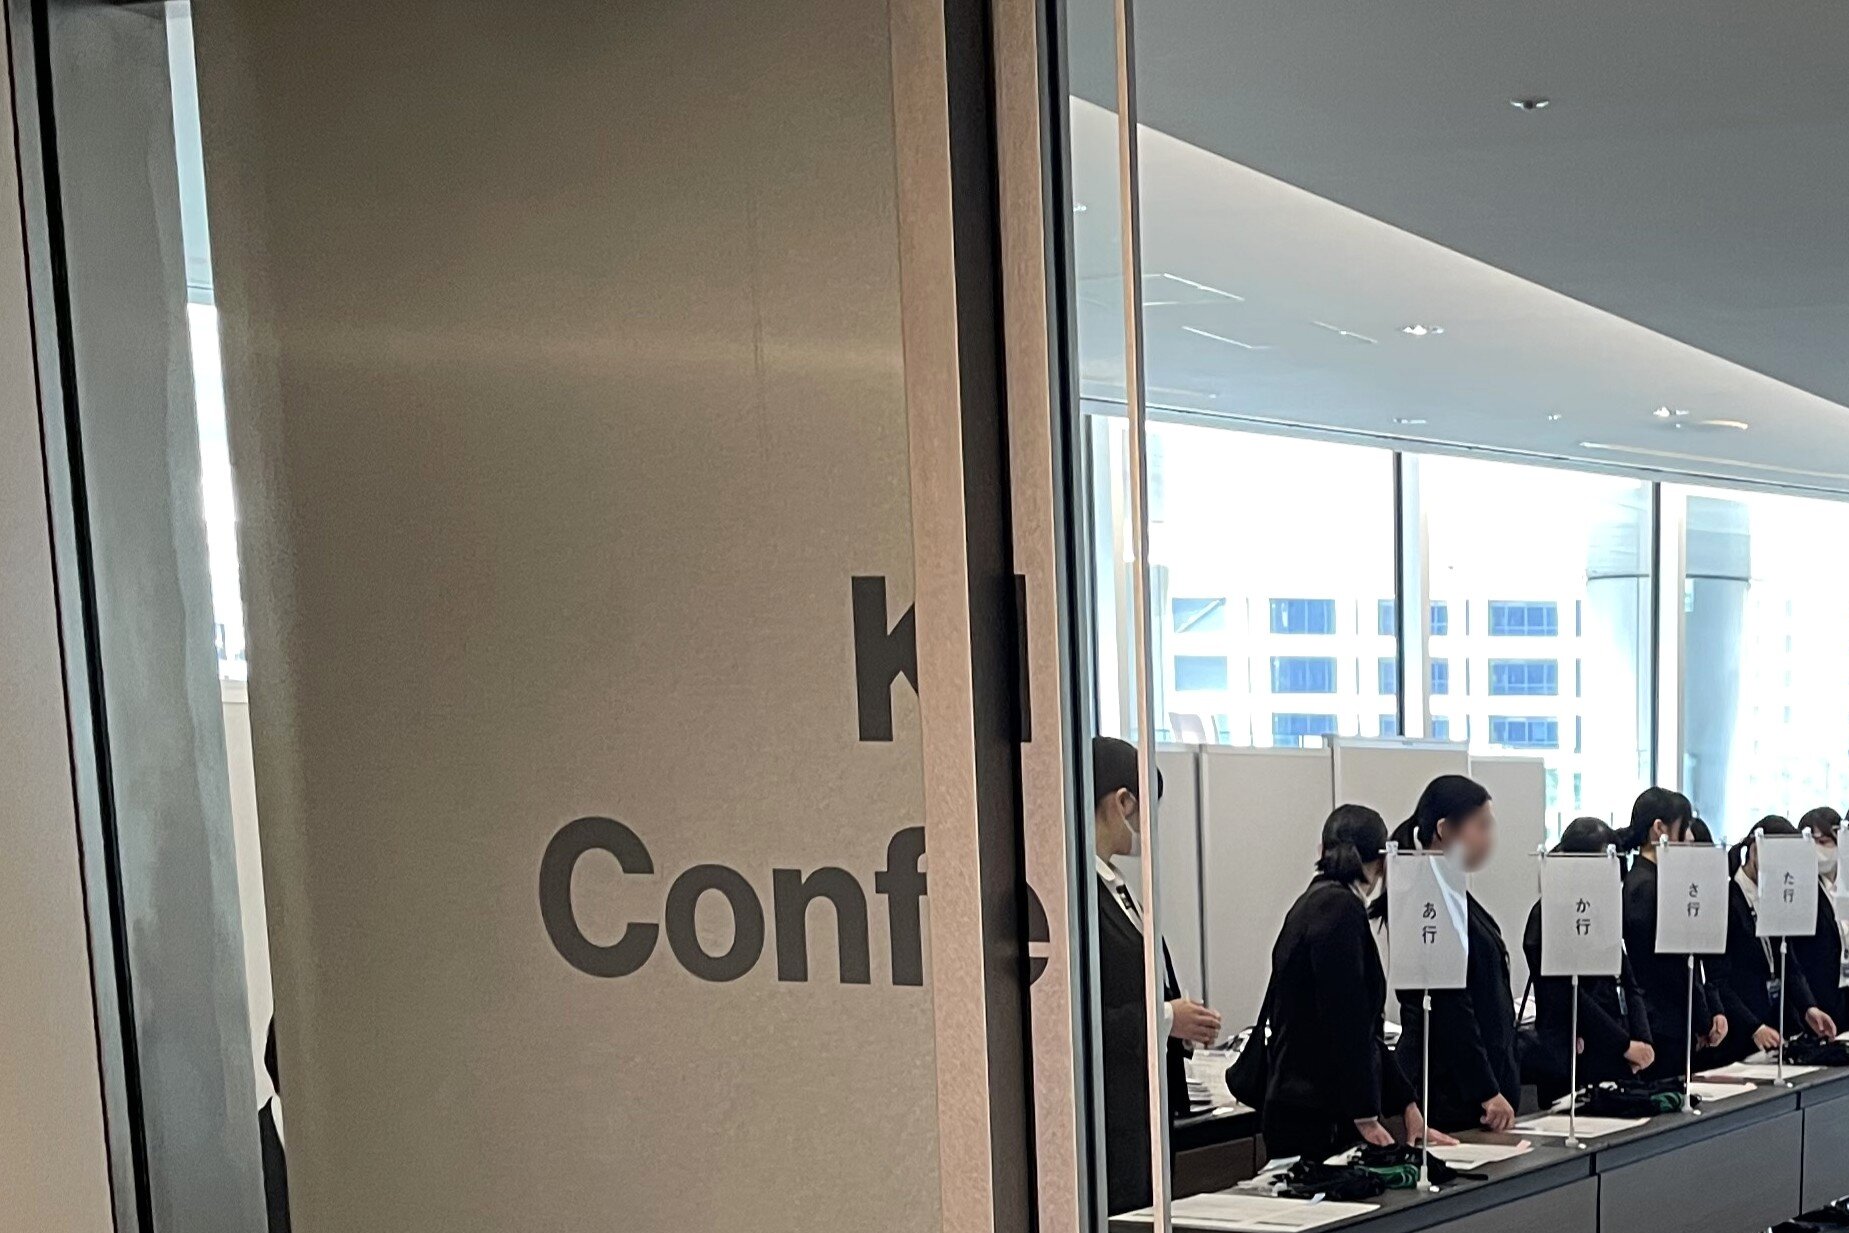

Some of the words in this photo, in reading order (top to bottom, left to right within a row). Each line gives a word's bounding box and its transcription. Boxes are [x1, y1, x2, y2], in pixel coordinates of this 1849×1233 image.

[1686, 882, 1701, 918] さ行
[1783, 871, 1795, 904] た行
[1421, 901, 1438, 945] あ行
[1575, 898, 1592, 936] か行
